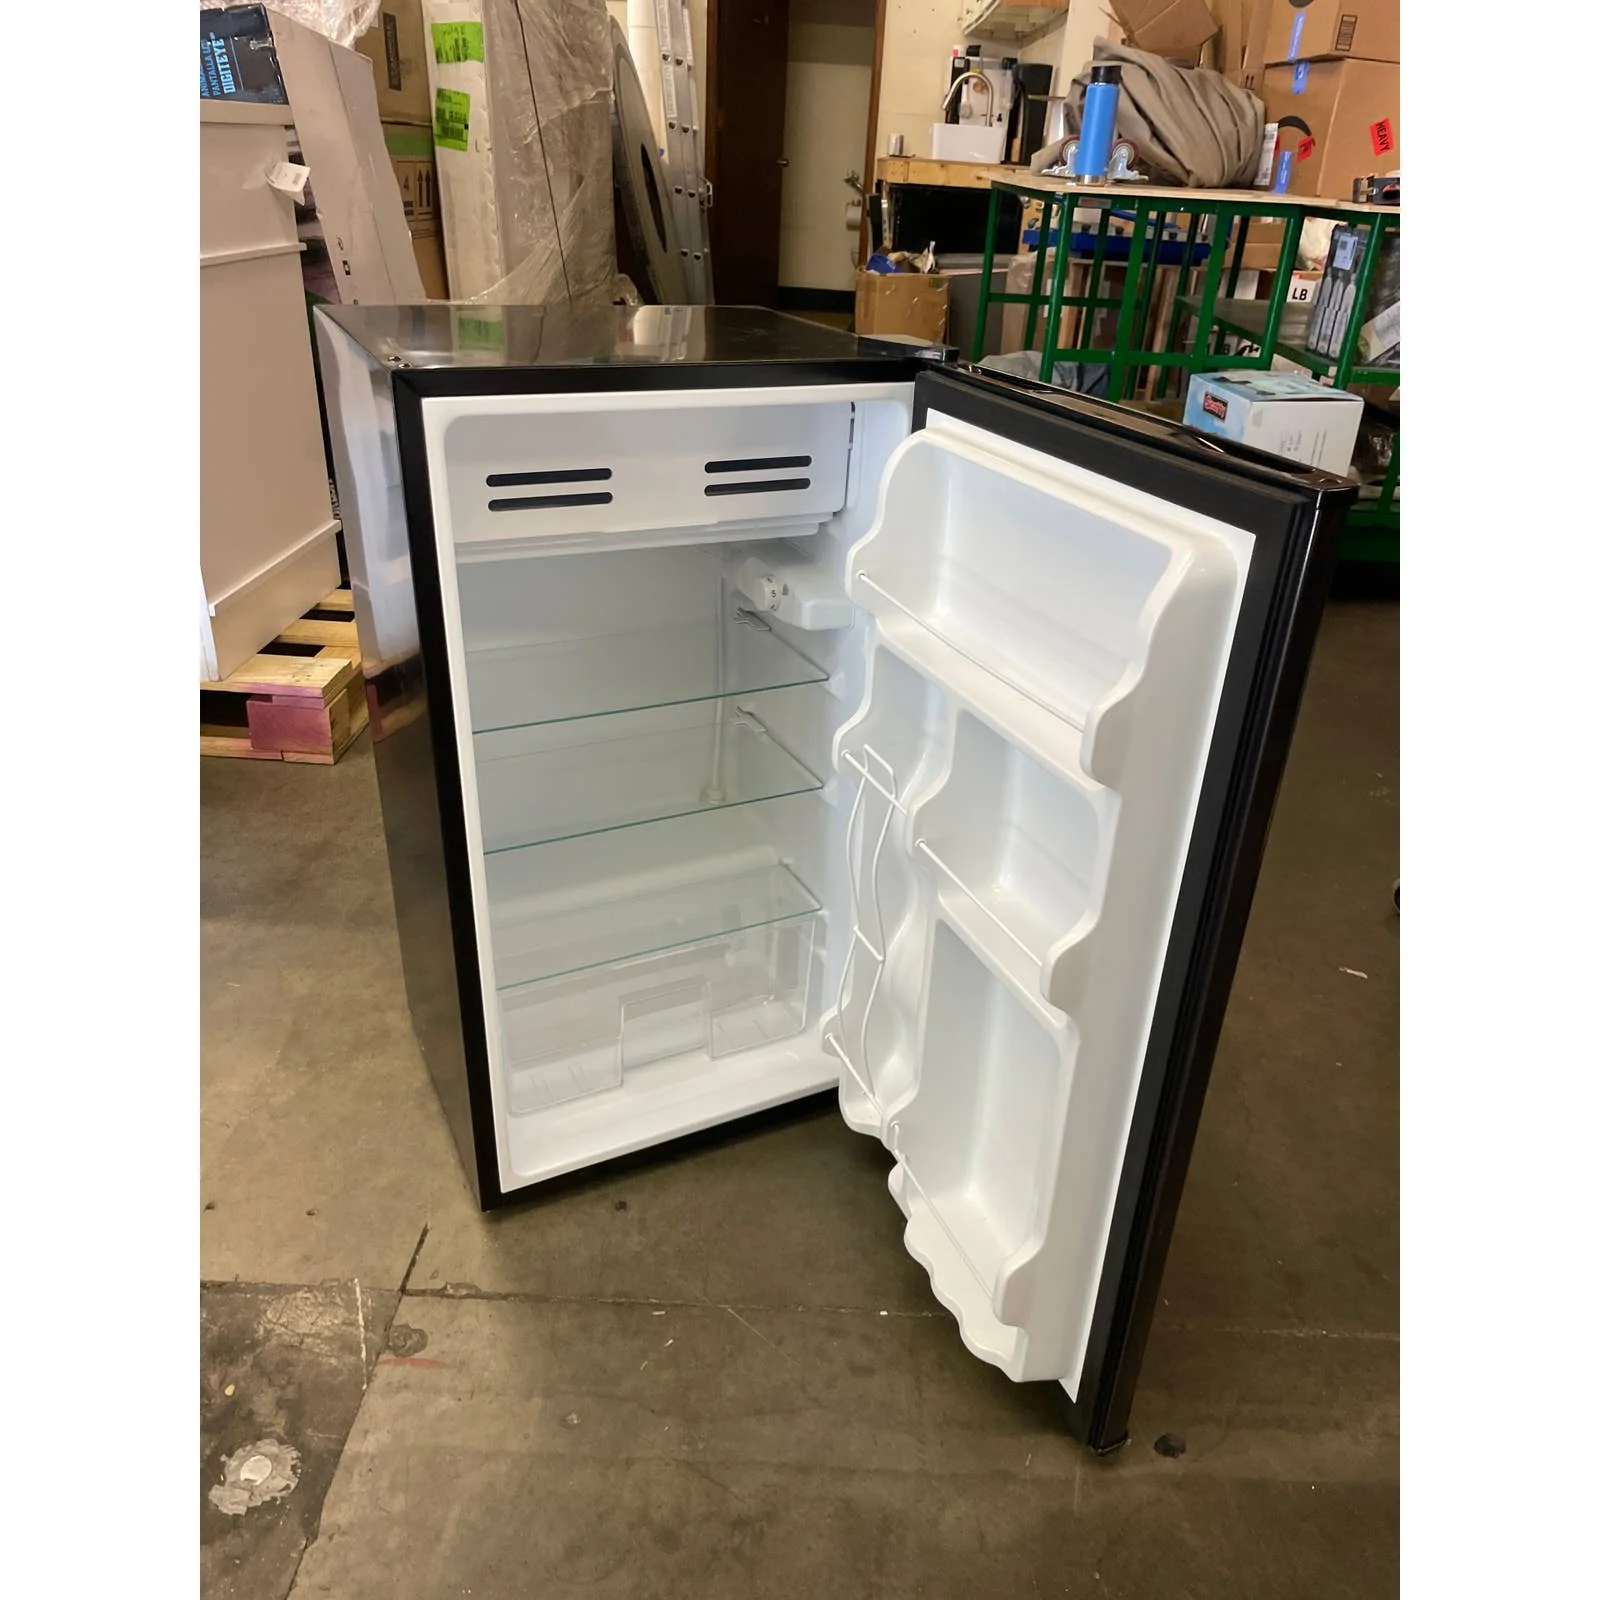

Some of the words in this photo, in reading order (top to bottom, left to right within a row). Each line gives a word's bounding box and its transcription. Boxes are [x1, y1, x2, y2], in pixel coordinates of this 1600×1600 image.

[204, 54, 221, 96] PANTALLA
[1375, 121, 1391, 152] HEAVY
[1291, 287, 1308, 301] LB
[771, 589, 777, 598] 5
